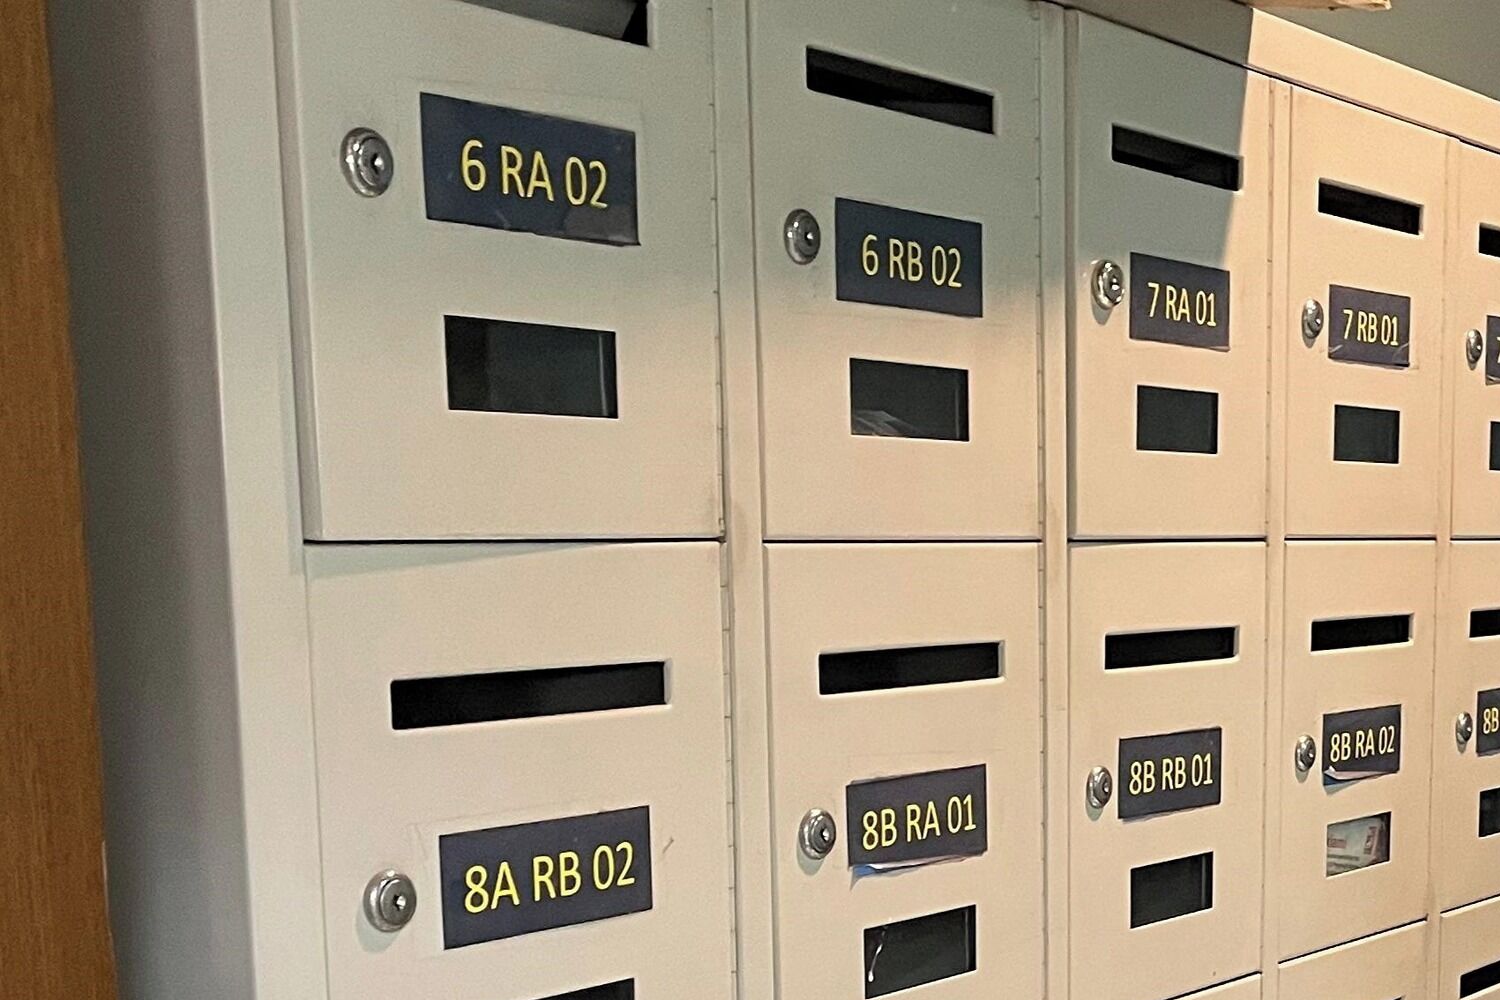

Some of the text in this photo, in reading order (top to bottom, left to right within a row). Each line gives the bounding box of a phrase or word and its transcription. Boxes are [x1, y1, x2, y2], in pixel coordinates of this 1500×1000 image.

[461, 139, 608, 208] 6 RA 02
[862, 234, 962, 288] 6 RB 02
[1147, 282, 1217, 327] 7 RA 01
[1343, 309, 1399, 346] 7 RB 01
[1483, 707, 1500, 735] 8B
[1330, 725, 1395, 763] 8B RA 02
[1129, 752, 1213, 795] 8B RB 01
[862, 794, 977, 851] 8B RA 01
[464, 841, 635, 914] 8A RB 02
